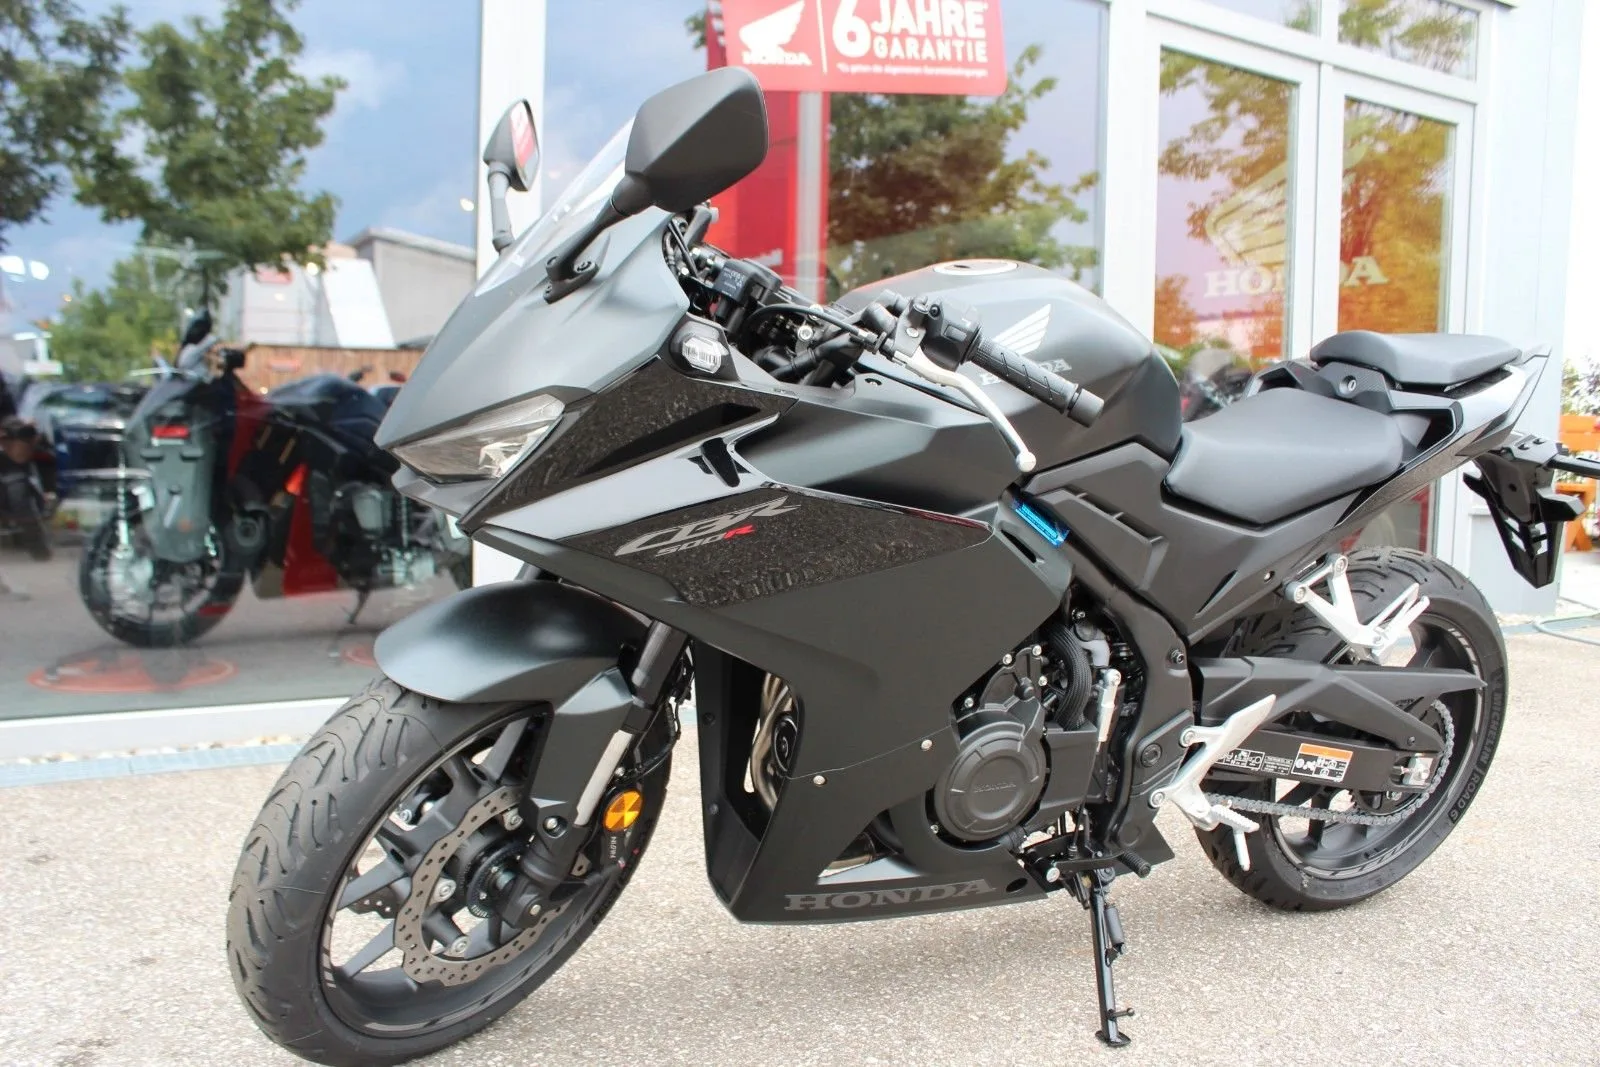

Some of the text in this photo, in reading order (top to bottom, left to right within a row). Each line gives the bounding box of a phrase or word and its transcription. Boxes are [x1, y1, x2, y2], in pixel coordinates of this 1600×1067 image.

[832, 0, 872, 58] 6
[872, 36, 989, 63] GARANTIE
[614, 495, 801, 557] CBR
[655, 524, 756, 558] 500R
[1479, 691, 1505, 766] MICHELIN
[1457, 770, 1481, 810] ROAD
[784, 878, 997, 911] HONDA
